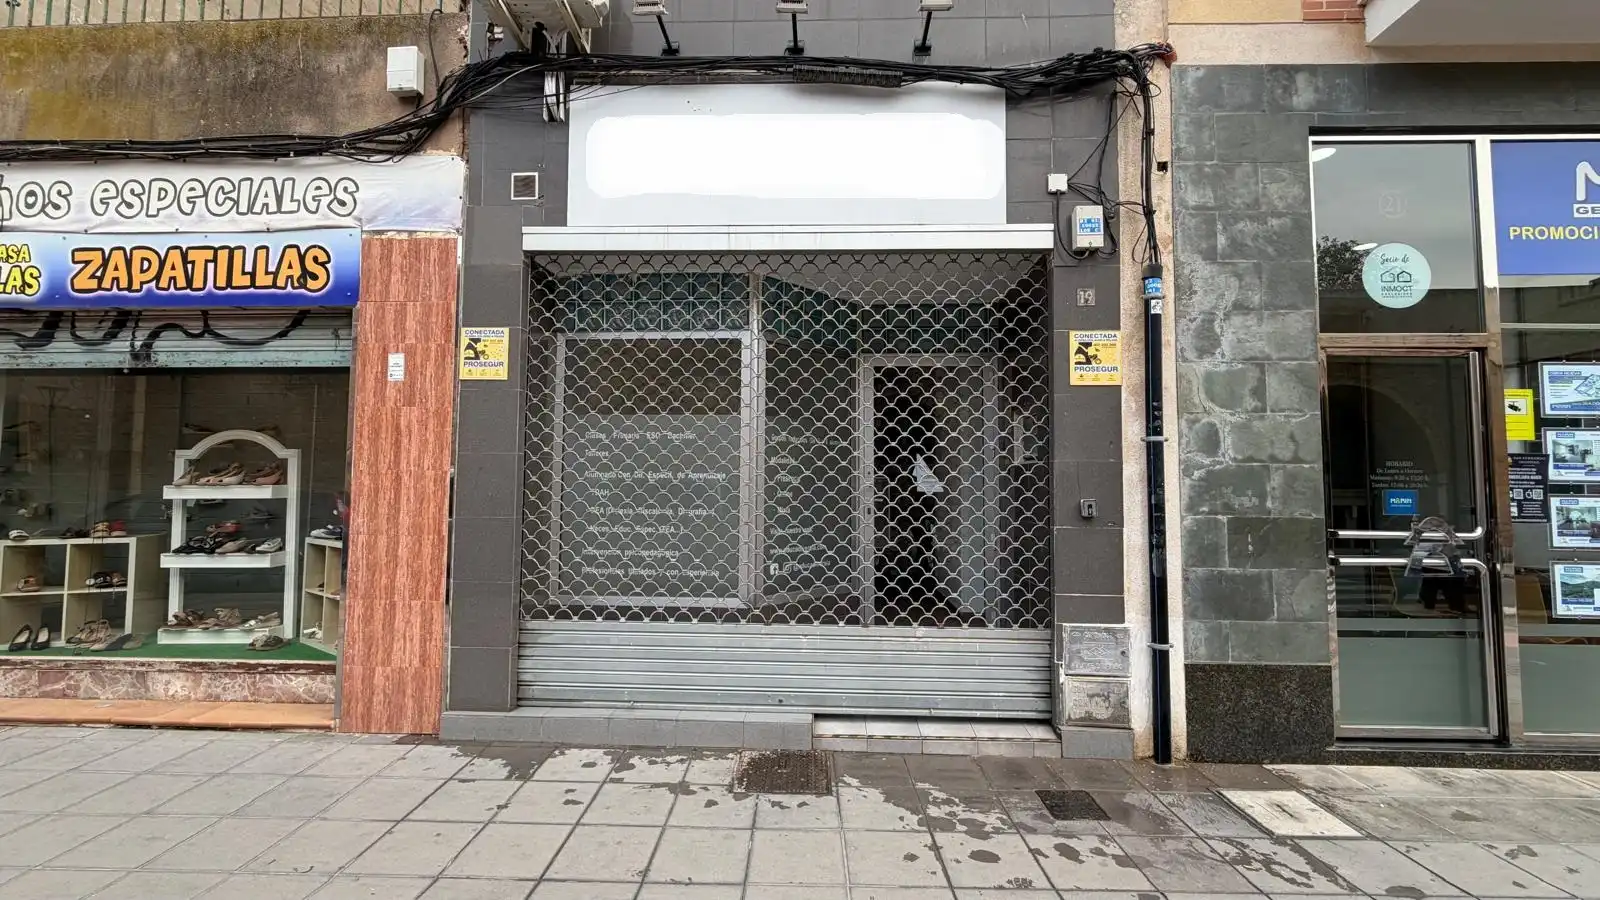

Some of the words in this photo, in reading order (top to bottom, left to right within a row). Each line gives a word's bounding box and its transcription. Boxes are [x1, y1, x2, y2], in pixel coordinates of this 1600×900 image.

[1509, 226, 1599, 240] PROMOCI
[71, 245, 332, 294] ZAPATILLAS
[1080, 291, 1093, 304] 19
